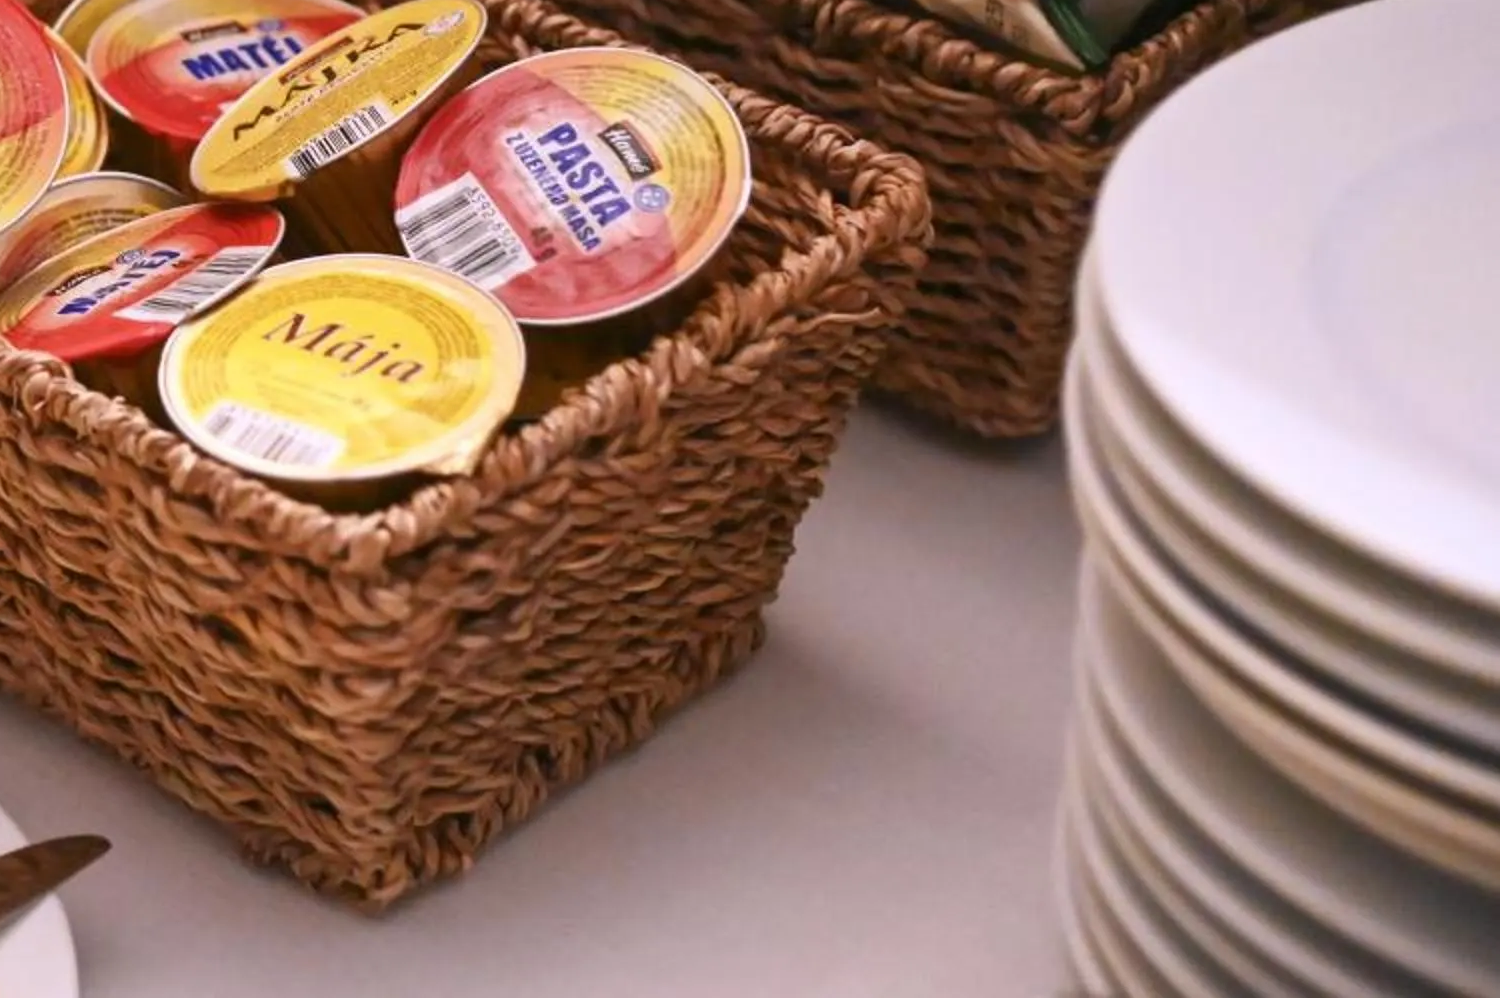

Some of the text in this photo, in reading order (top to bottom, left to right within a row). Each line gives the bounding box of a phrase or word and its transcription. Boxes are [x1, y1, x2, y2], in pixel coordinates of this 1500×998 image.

[537, 122, 632, 228] PASTA
[560, 204, 601, 252] MASA
[261, 312, 427, 384] Mája
